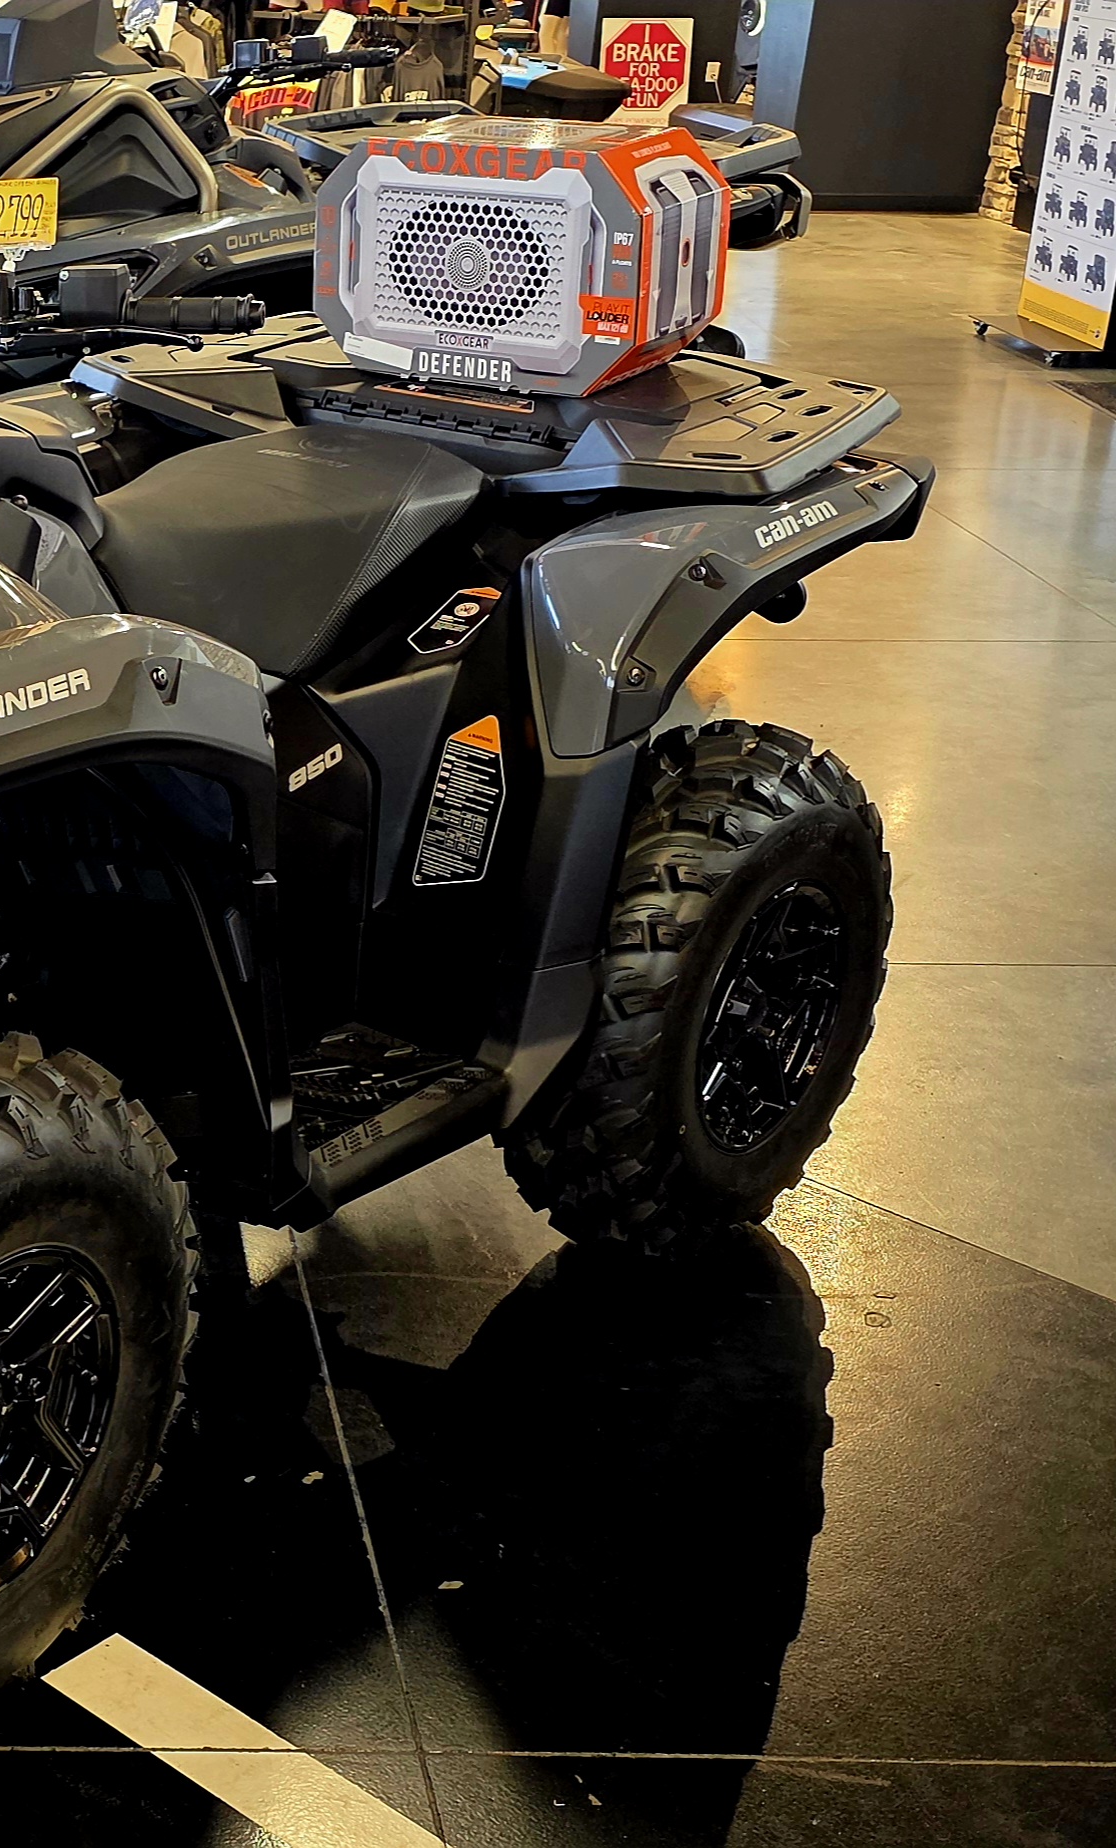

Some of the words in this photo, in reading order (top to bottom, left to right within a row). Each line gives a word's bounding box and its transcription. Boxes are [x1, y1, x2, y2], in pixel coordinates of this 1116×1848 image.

[645, 24, 650, 43] I
[612, 43, 681, 62] BRAKE
[629, 62, 660, 77] FOR
[613, 231, 634, 246] IP67
[592, 302, 619, 312] PLAY
[586, 310, 630, 325] LOUDER
[439, 332, 489, 349] ECOXGEAR
[419, 352, 512, 383] DEFENDER
[754, 501, 839, 548] can-am
[289, 743, 342, 792] 850
